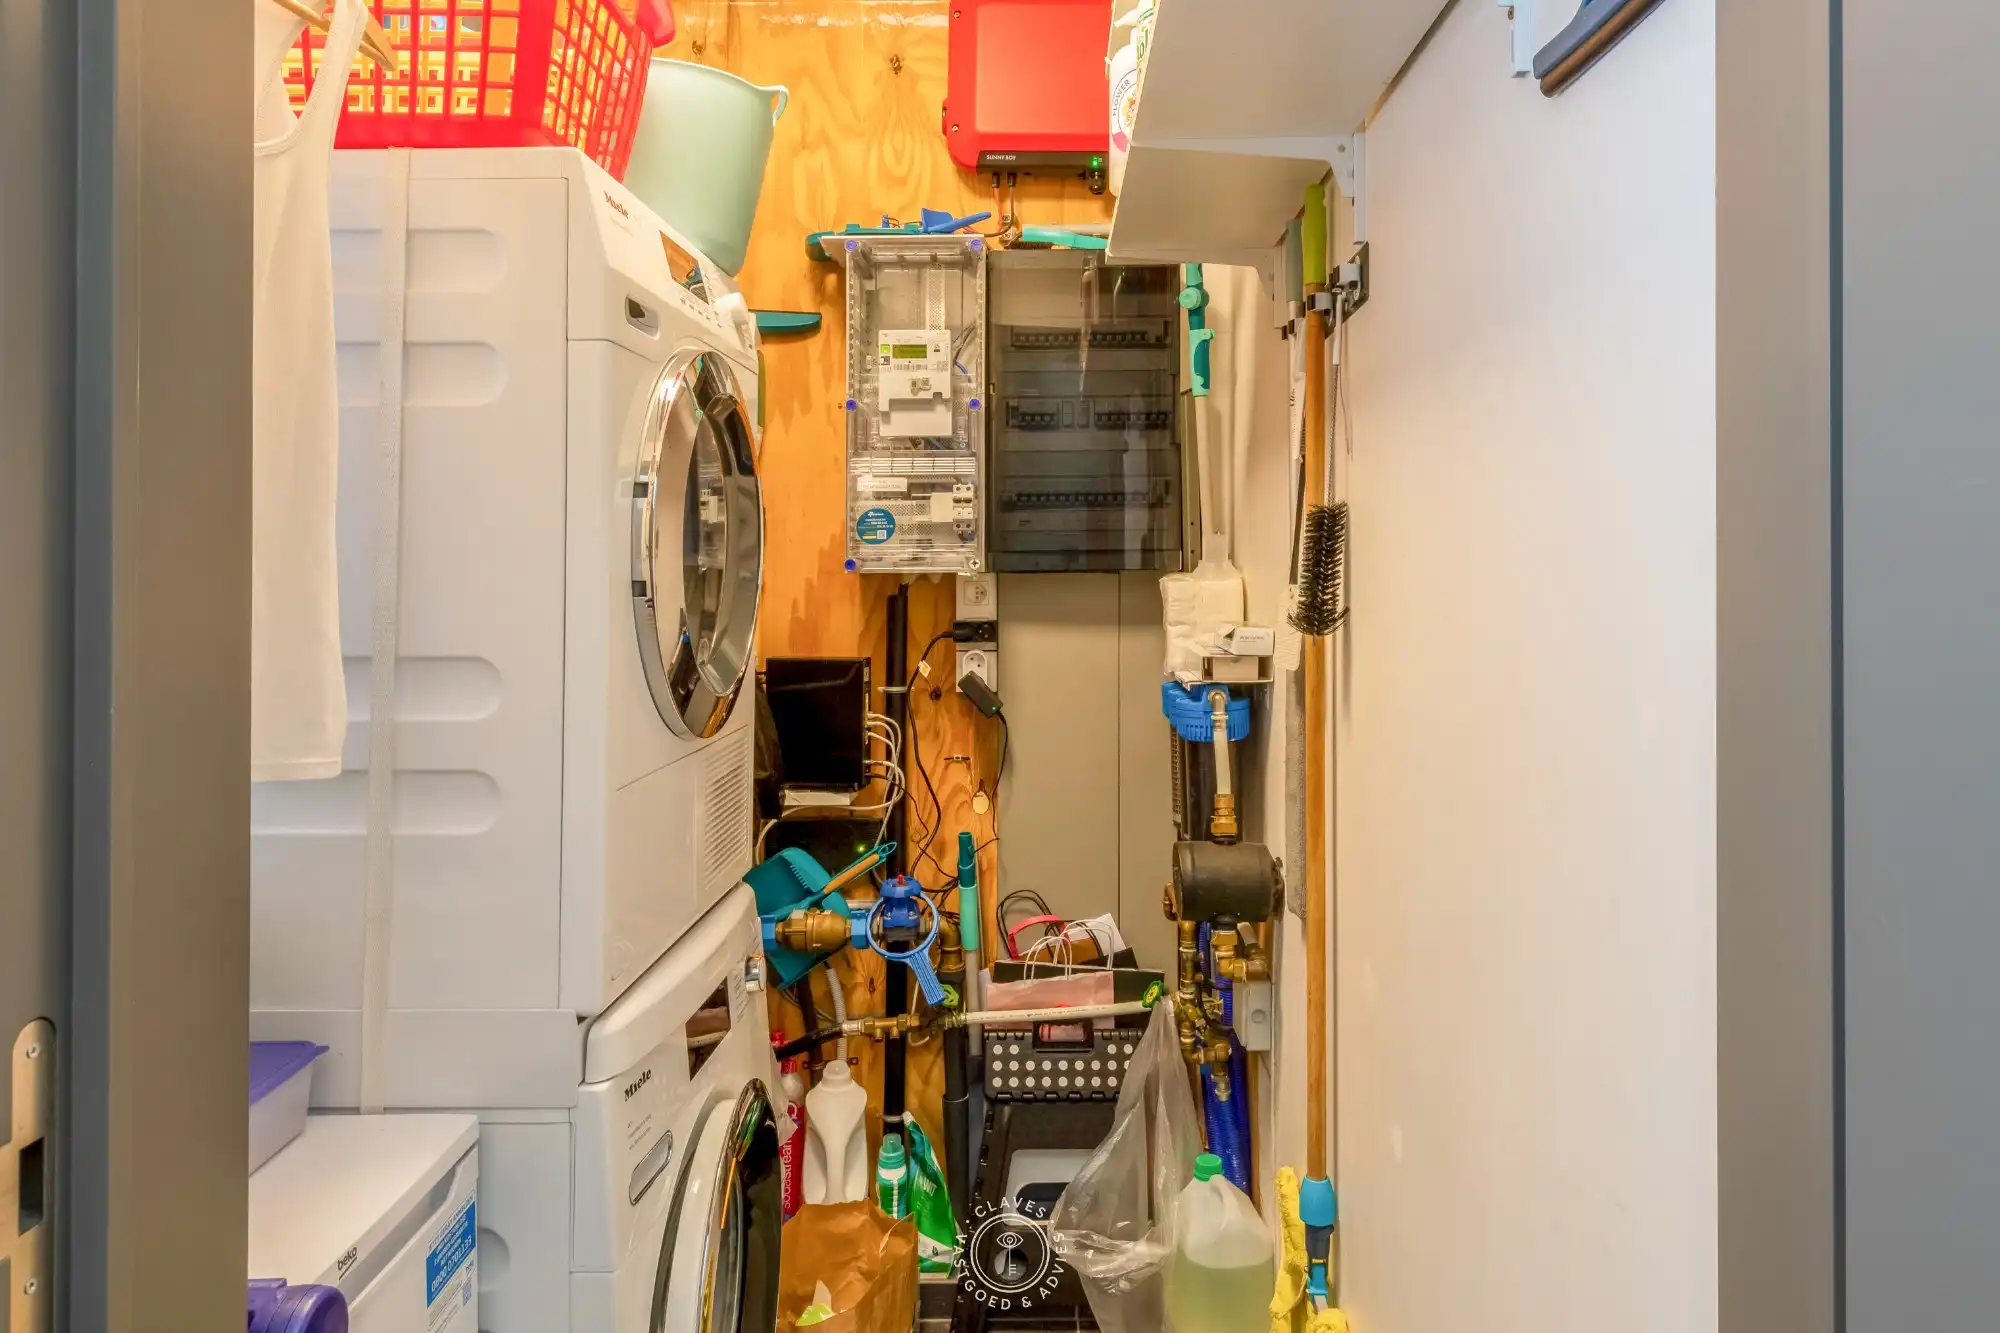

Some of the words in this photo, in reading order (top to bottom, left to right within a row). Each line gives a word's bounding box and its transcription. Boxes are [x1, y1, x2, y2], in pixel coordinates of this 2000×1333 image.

[1112, 79, 1130, 116] FLOWER
[603, 189, 628, 219] Miele
[624, 1069, 652, 1102] Miele
[337, 1246, 357, 1271] beko
